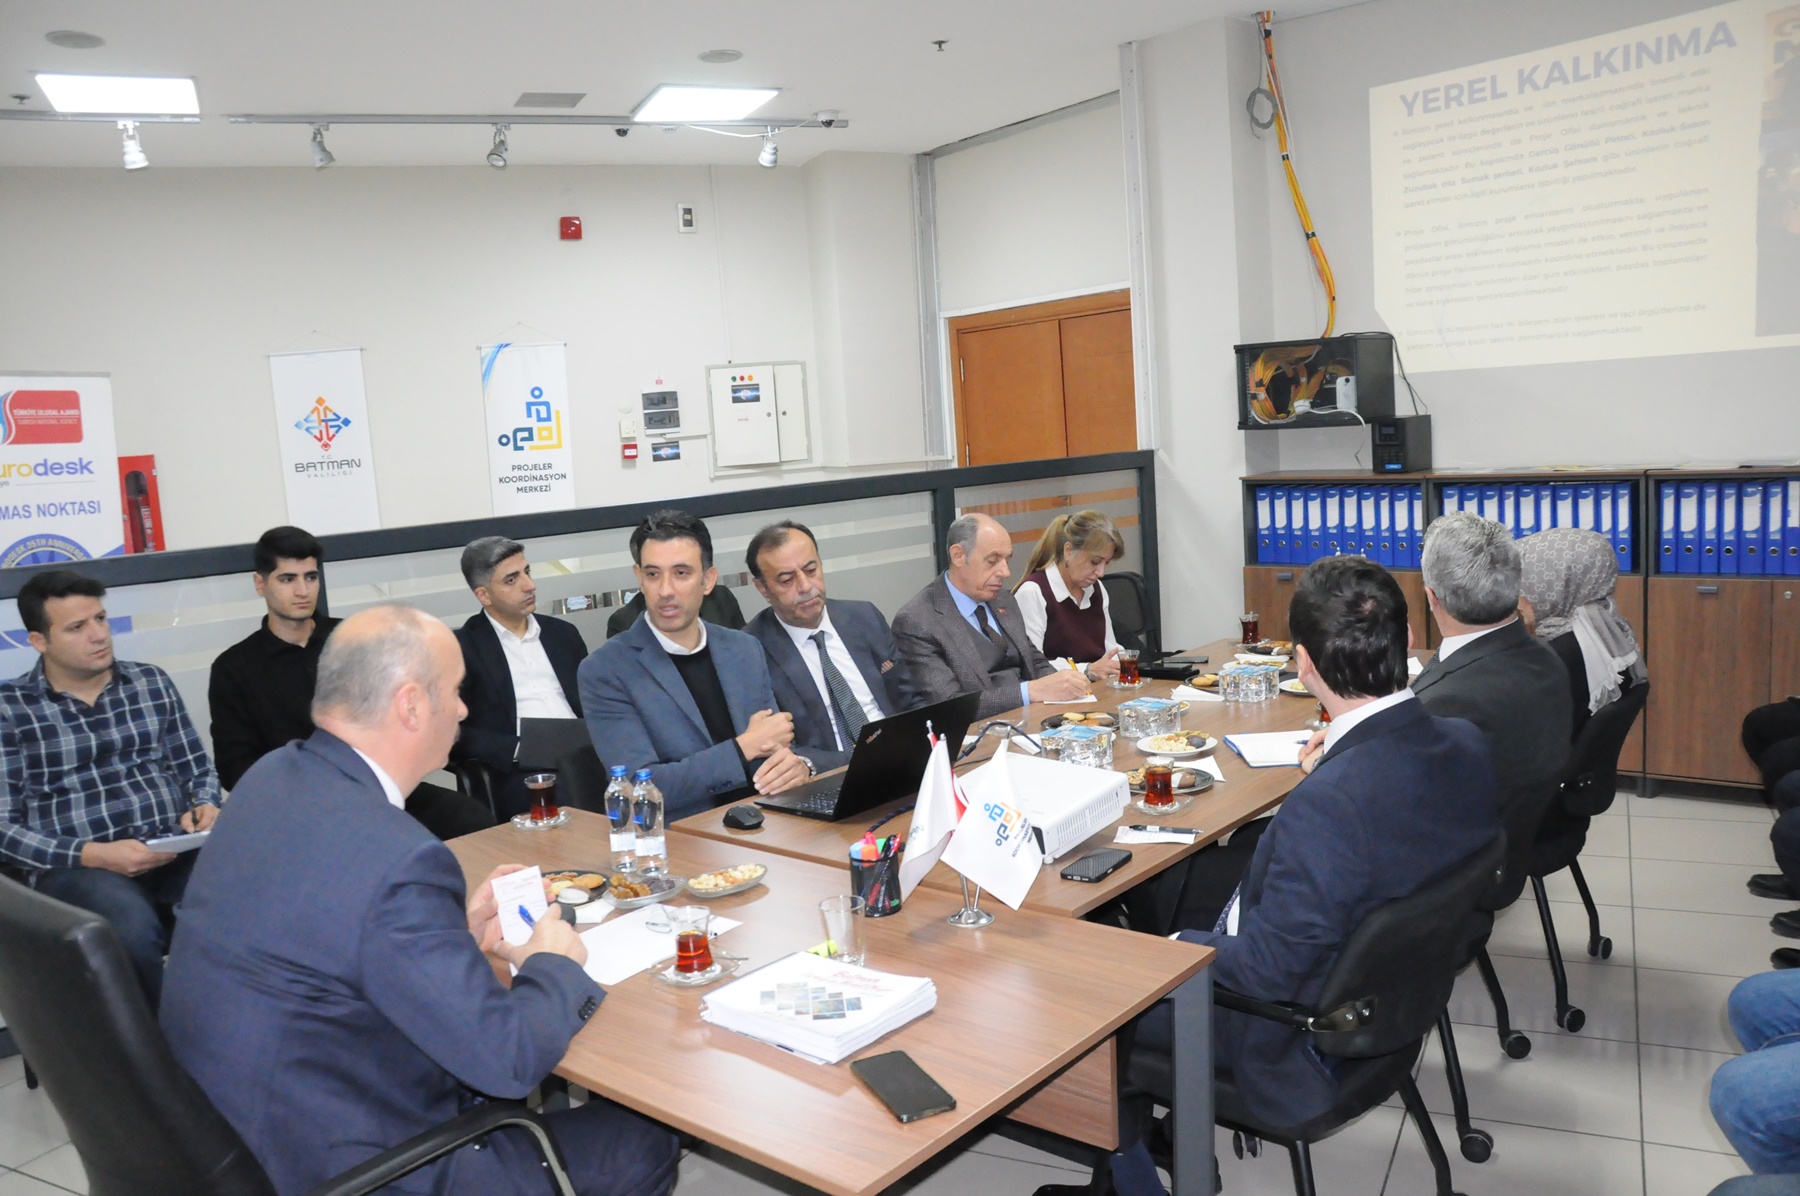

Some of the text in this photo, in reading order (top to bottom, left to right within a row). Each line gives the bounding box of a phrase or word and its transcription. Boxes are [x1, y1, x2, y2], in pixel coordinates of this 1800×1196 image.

[1399, 74, 1508, 118] YEREL
[1517, 20, 1737, 95] KALKINMA
[1434, 119, 1454, 131] yerel
[1525, 119, 1535, 127] ve
[1402, 157, 1411, 165] ve
[1418, 152, 1444, 163] patent
[1510, 137, 1522, 146] de
[1529, 133, 1552, 142] Proje
[1560, 126, 1581, 136] Ofisi
[1460, 173, 1489, 184] Sumak
[1528, 162, 1559, 174] Kozluk
[1602, 150, 1620, 163] gibi
[1479, 153, 1524, 167] kapsamda
[1404, 228, 1424, 237] Proje
[1495, 215, 1517, 225] proje
[1654, 226, 1666, 234] ve
[1431, 268, 1452, 278] proje
[1641, 243, 1655, 251] Bu
[1543, 271, 1560, 280] gün
[1553, 316, 1572, 324] olan
[1608, 311, 1618, 319] ve
[1692, 303, 1707, 311] de
[0, 457, 94, 479] urodesk
[294, 458, 361, 473] BATMAN
[511, 462, 553, 472] PROJELER
[498, 471, 567, 485] KOORDİNASYON
[516, 484, 552, 494] MERKEZİ
[0, 500, 101, 520] MAS NOKTASI
